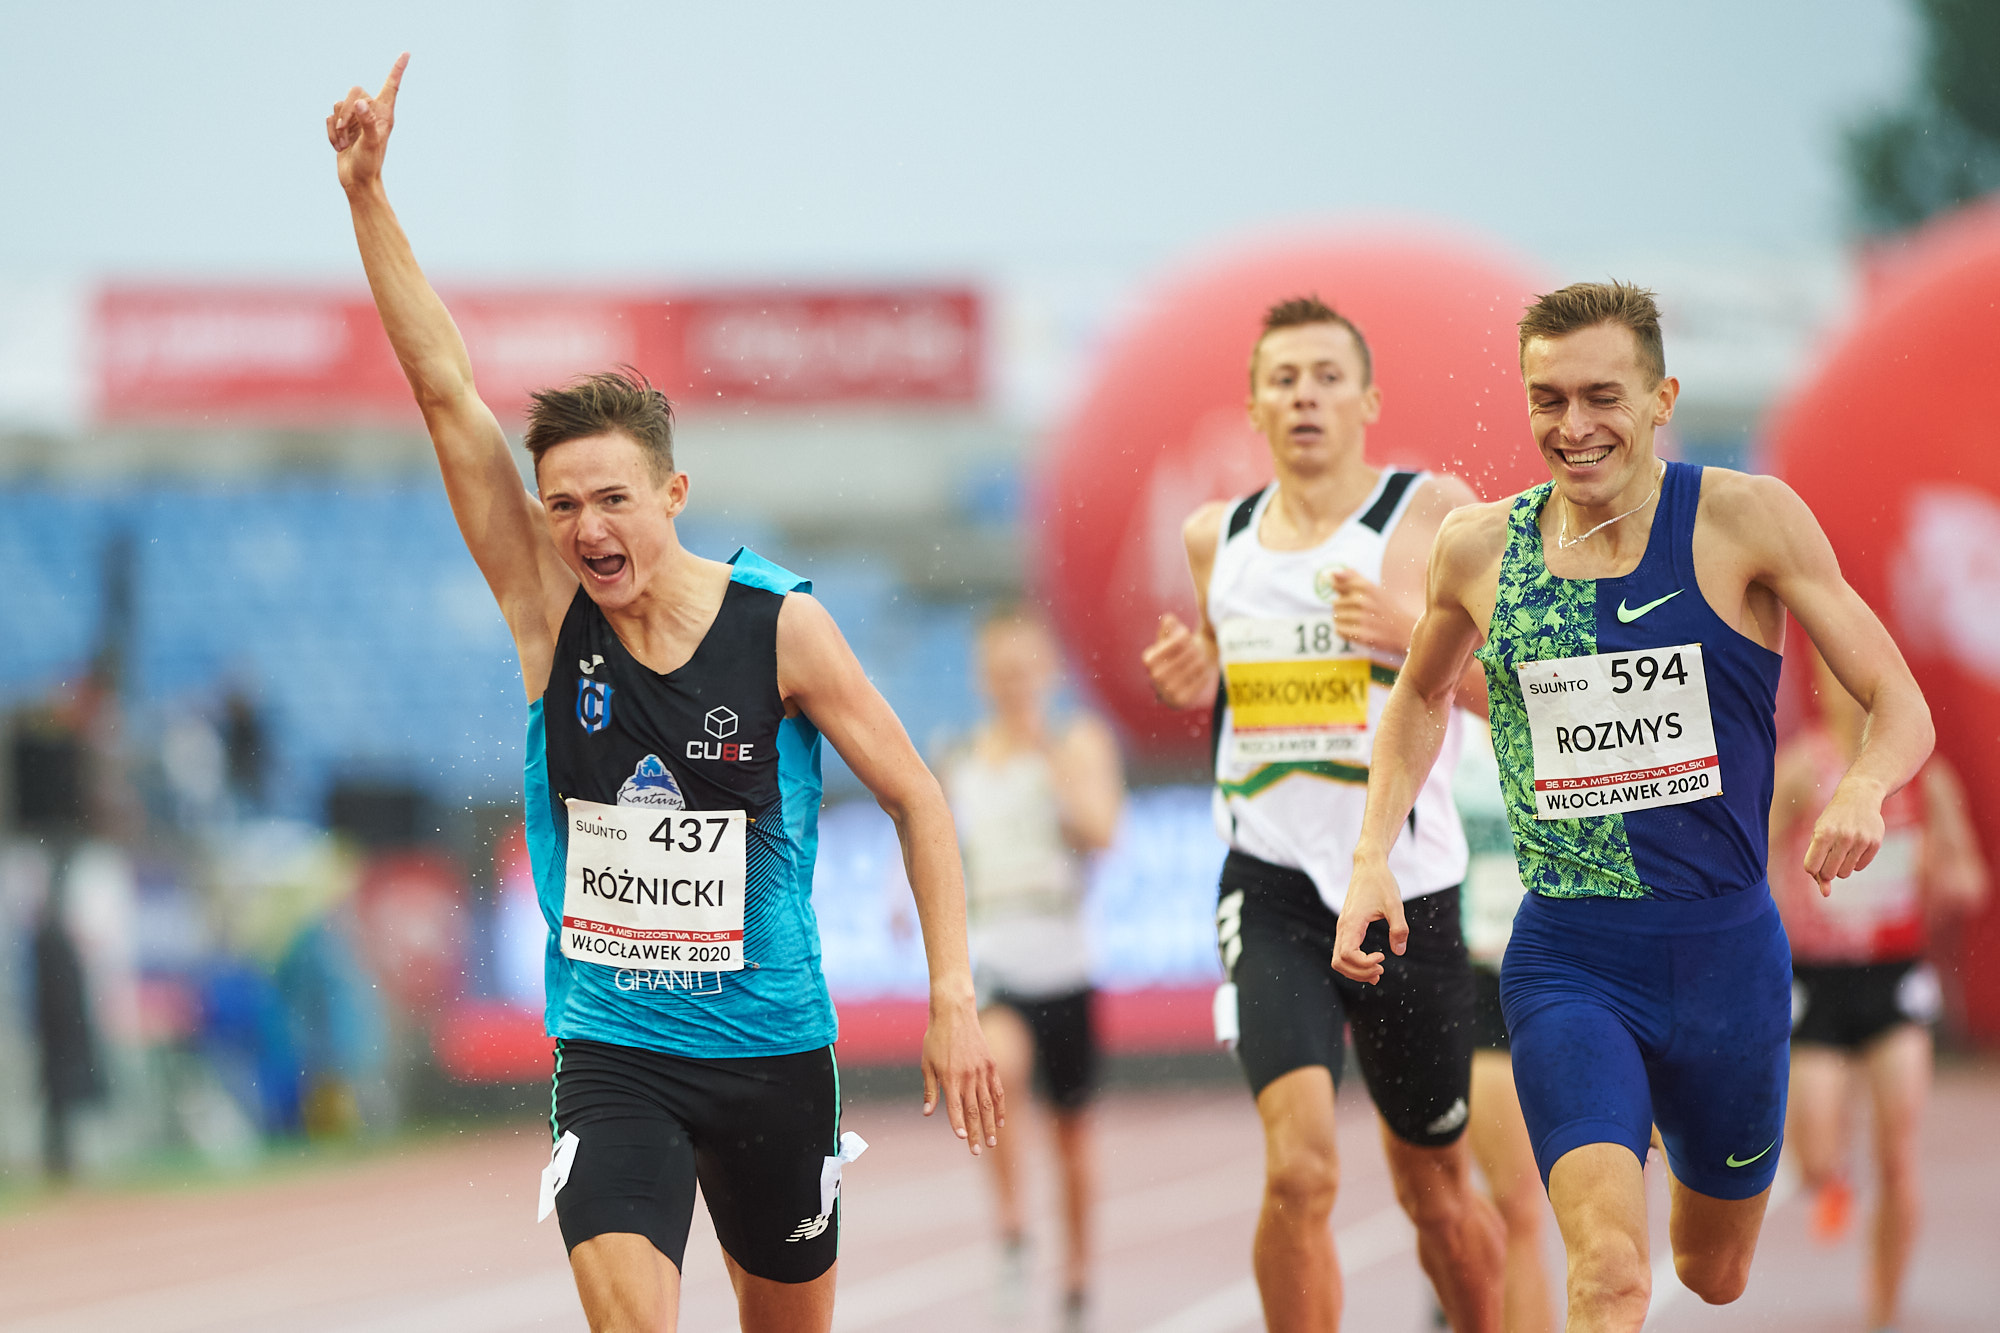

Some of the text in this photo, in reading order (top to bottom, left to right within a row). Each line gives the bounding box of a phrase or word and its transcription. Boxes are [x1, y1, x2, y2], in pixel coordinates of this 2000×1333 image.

[1529, 679, 1589, 695] SUUNTO
[1611, 653, 1688, 694] 594
[1556, 712, 1683, 754] ROZMYS
[686, 741, 754, 761] CUBE
[1563, 778, 1589, 788] PZLA
[1590, 769, 1667, 786] MISTRZOSTWA
[1668, 759, 1706, 775] POLSKI
[1546, 773, 1709, 810] WŁOCŁAWEK 2020
[576, 820, 627, 841] SUUNTO
[649, 817, 730, 853] 437
[582, 866, 724, 907] RÓŻNICKI
[590, 923, 615, 934] PZLA
[616, 928, 691, 940] MISTRZOSTWA
[692, 932, 730, 942] POLSKI
[572, 934, 731, 962] WŁOCŁAWEK 2020
